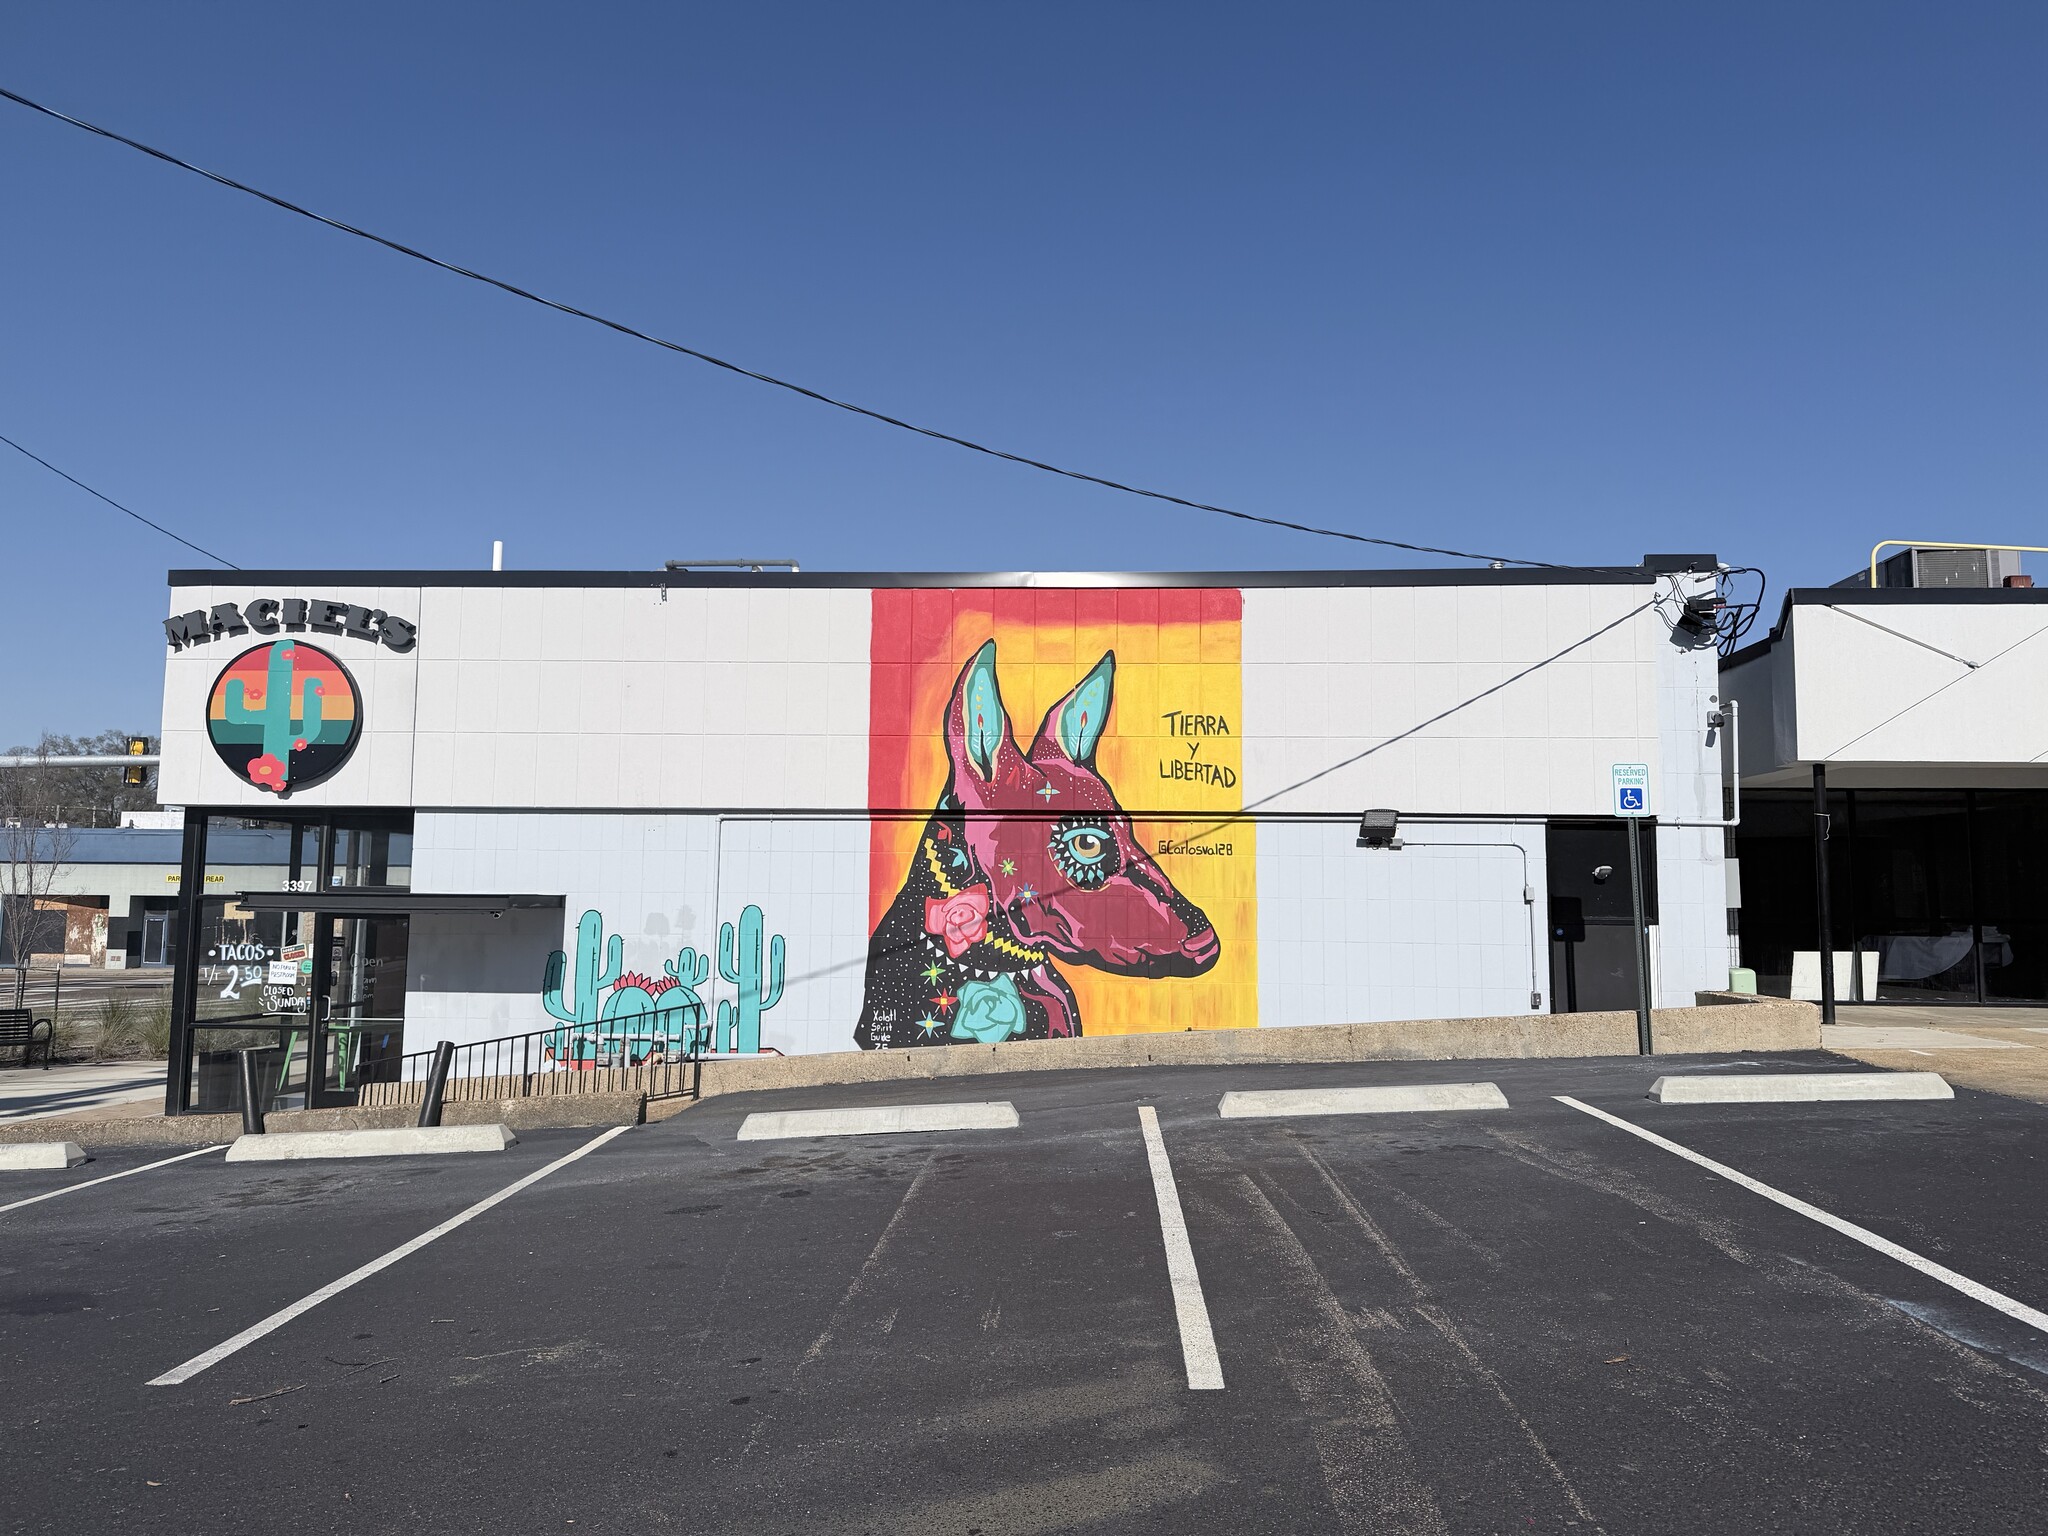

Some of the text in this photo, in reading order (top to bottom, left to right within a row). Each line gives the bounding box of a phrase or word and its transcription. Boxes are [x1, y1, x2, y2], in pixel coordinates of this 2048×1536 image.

[162, 599, 417, 653] MACIEL'S
[1161, 710, 1230, 737] TIERRA
[1187, 742, 1200, 760] Y
[1160, 758, 1236, 788] LIBERTAD
[282, 880, 313, 892] 3397
[219, 943, 266, 961] TACOS
[263, 984, 294, 997] CLOSED
[873, 1009, 896, 1022] Xolotl
[870, 1022, 893, 1032] Spirit
[870, 1032, 891, 1042] Guide
